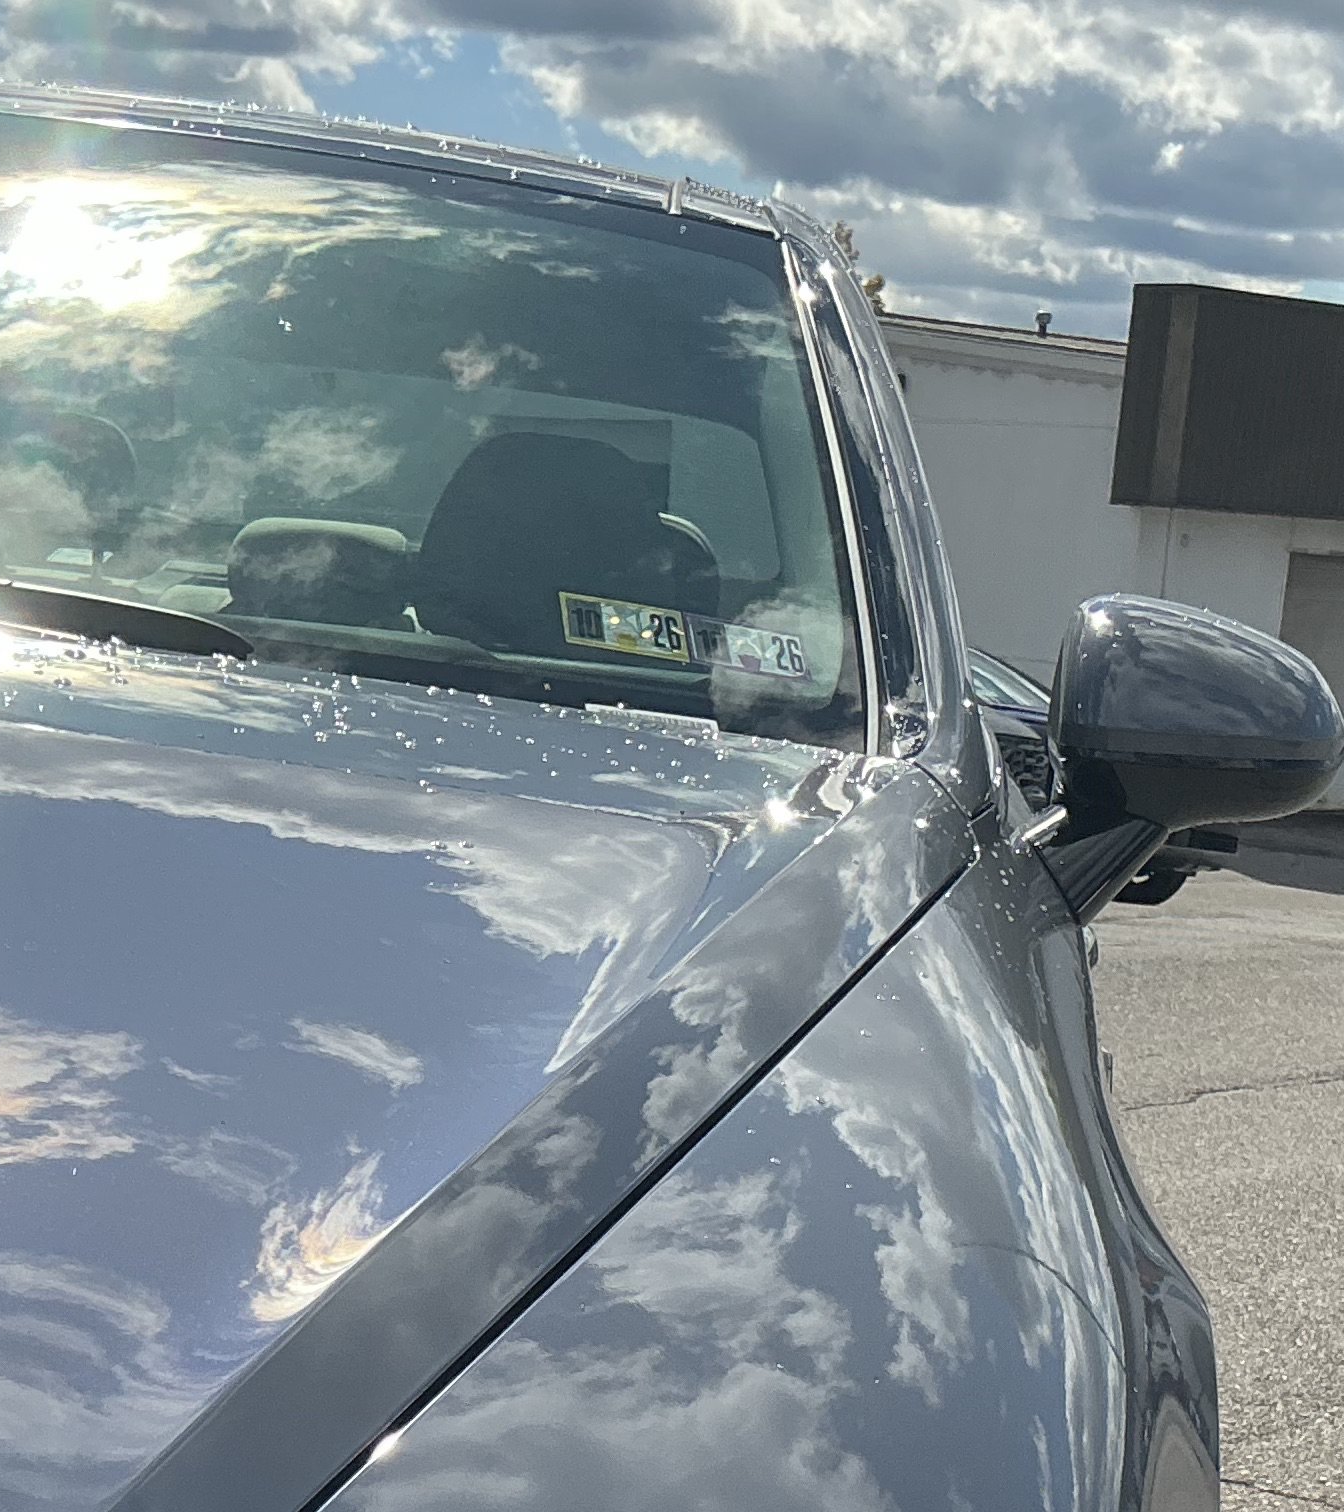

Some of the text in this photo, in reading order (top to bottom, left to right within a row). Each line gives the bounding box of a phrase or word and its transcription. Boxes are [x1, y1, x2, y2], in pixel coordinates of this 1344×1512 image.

[570, 607, 682, 651] 10 26
[771, 635, 804, 673] 26
